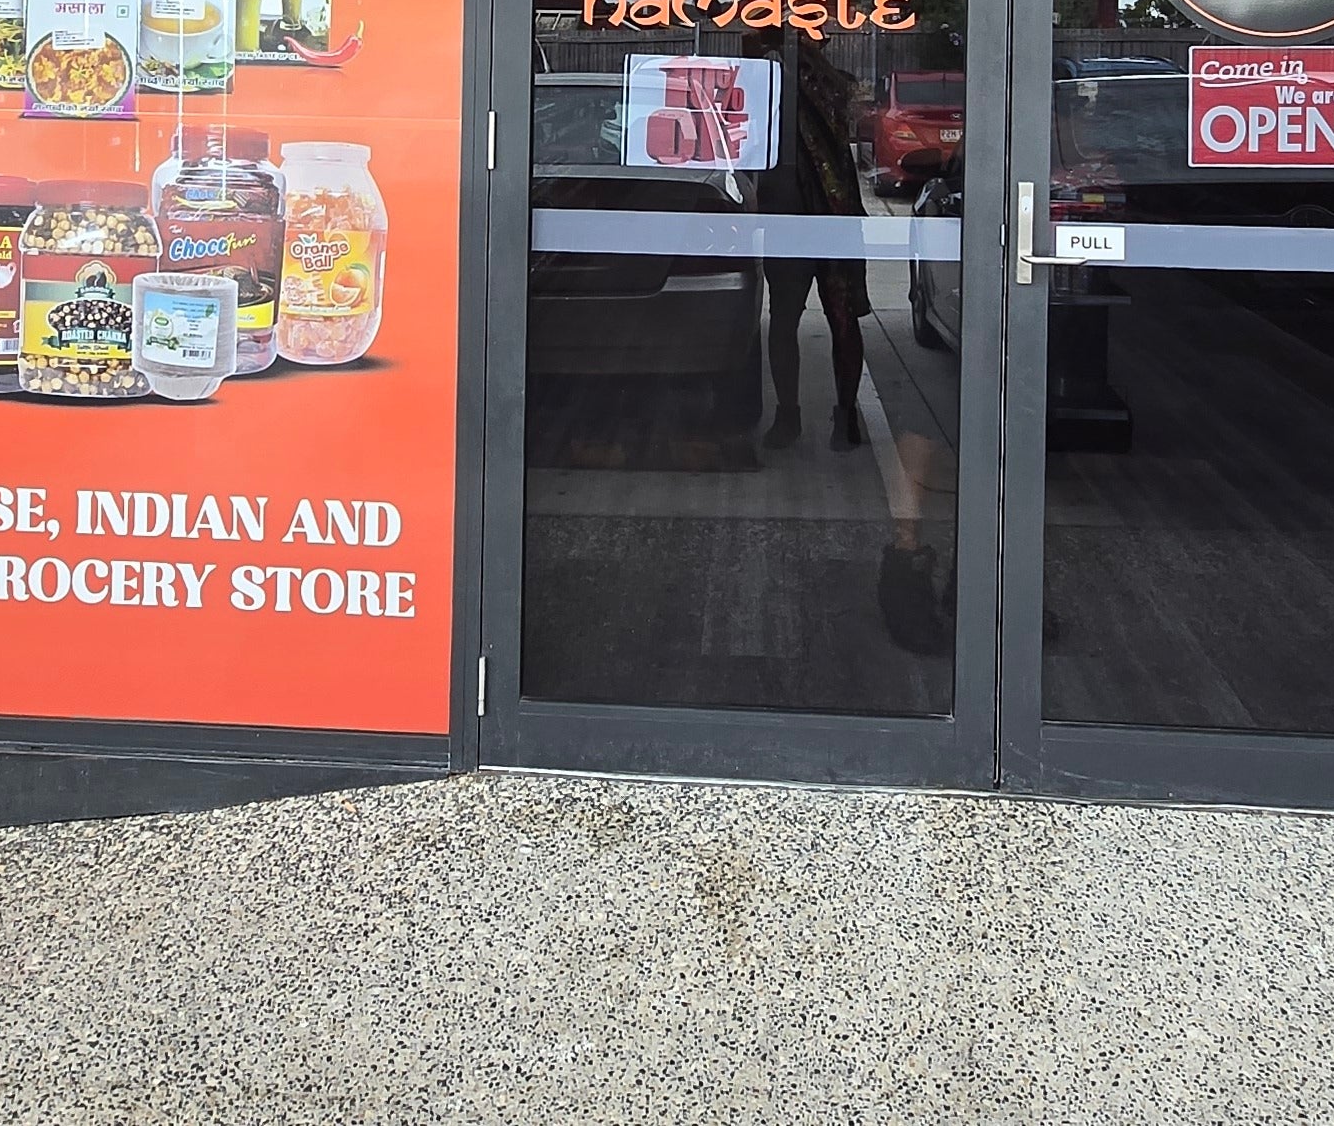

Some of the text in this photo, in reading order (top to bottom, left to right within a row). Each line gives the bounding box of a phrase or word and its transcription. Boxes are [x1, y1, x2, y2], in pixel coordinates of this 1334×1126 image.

[1200, 60, 1274, 80] Come
[1275, 85, 1306, 105] We
[291, 241, 350, 258] Orange
[1070, 236, 1113, 250] PULL
[303, 255, 333, 270] Ball
[75, 489, 268, 542] INDIAN
[281, 498, 402, 548] AND
[229, 564, 417, 619] STORE
